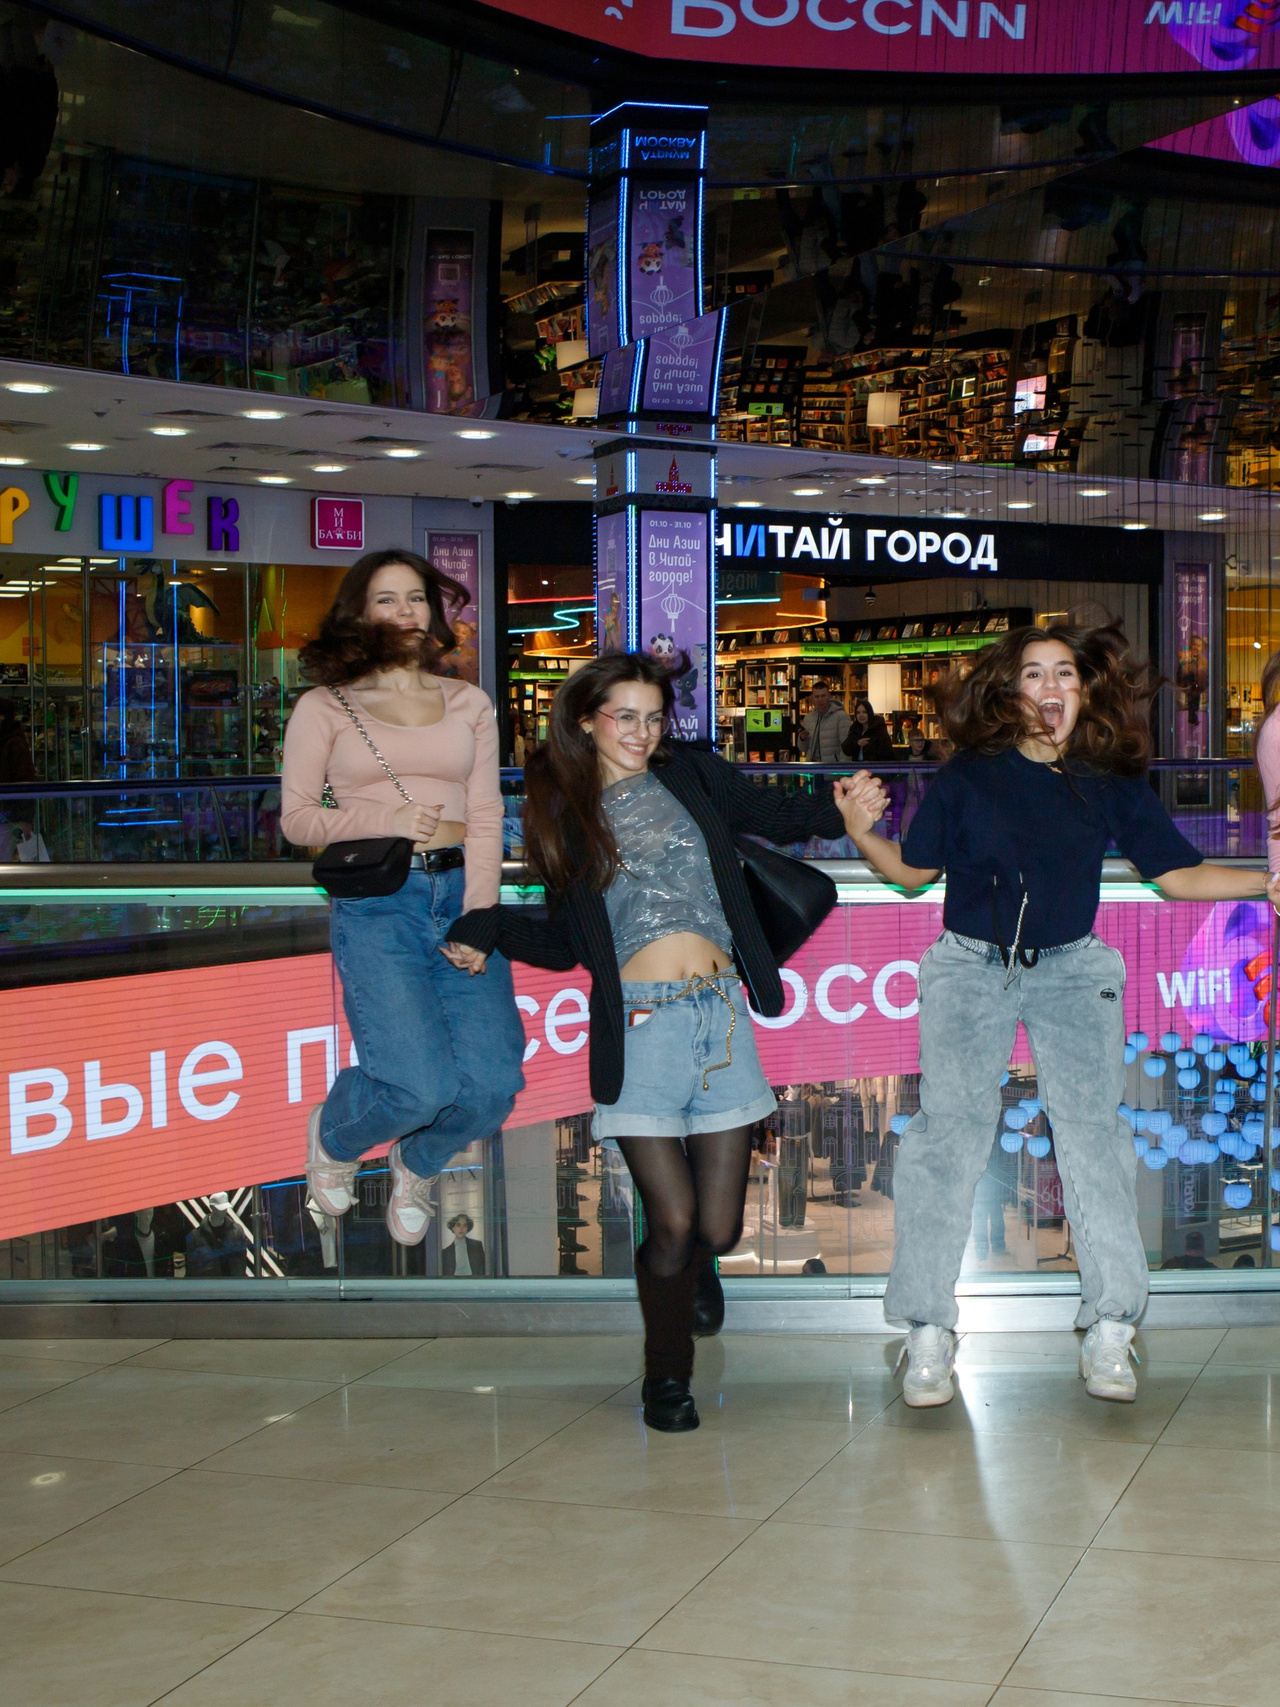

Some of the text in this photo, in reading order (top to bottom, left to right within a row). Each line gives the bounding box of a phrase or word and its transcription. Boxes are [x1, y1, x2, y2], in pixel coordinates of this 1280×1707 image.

[674, 521, 692, 529] 31.10
[648, 534, 700, 550] Дни Азии
[715, 516, 998, 571] ЧИТАЙ ГОРОД
[433, 546, 474, 557] Дни Азии
[660, 552, 697, 567] Читай-
[442, 559, 471, 570] Читай-
[446, 571, 468, 582] оде!
[649, 569, 693, 586] городе!
[670, 714, 699, 730] ТАЙ
[1156, 967, 1231, 1008] WiFi
[286, 1024, 359, 1104] п
[513, 987, 591, 1063] се
[740, 960, 920, 1029] осс
